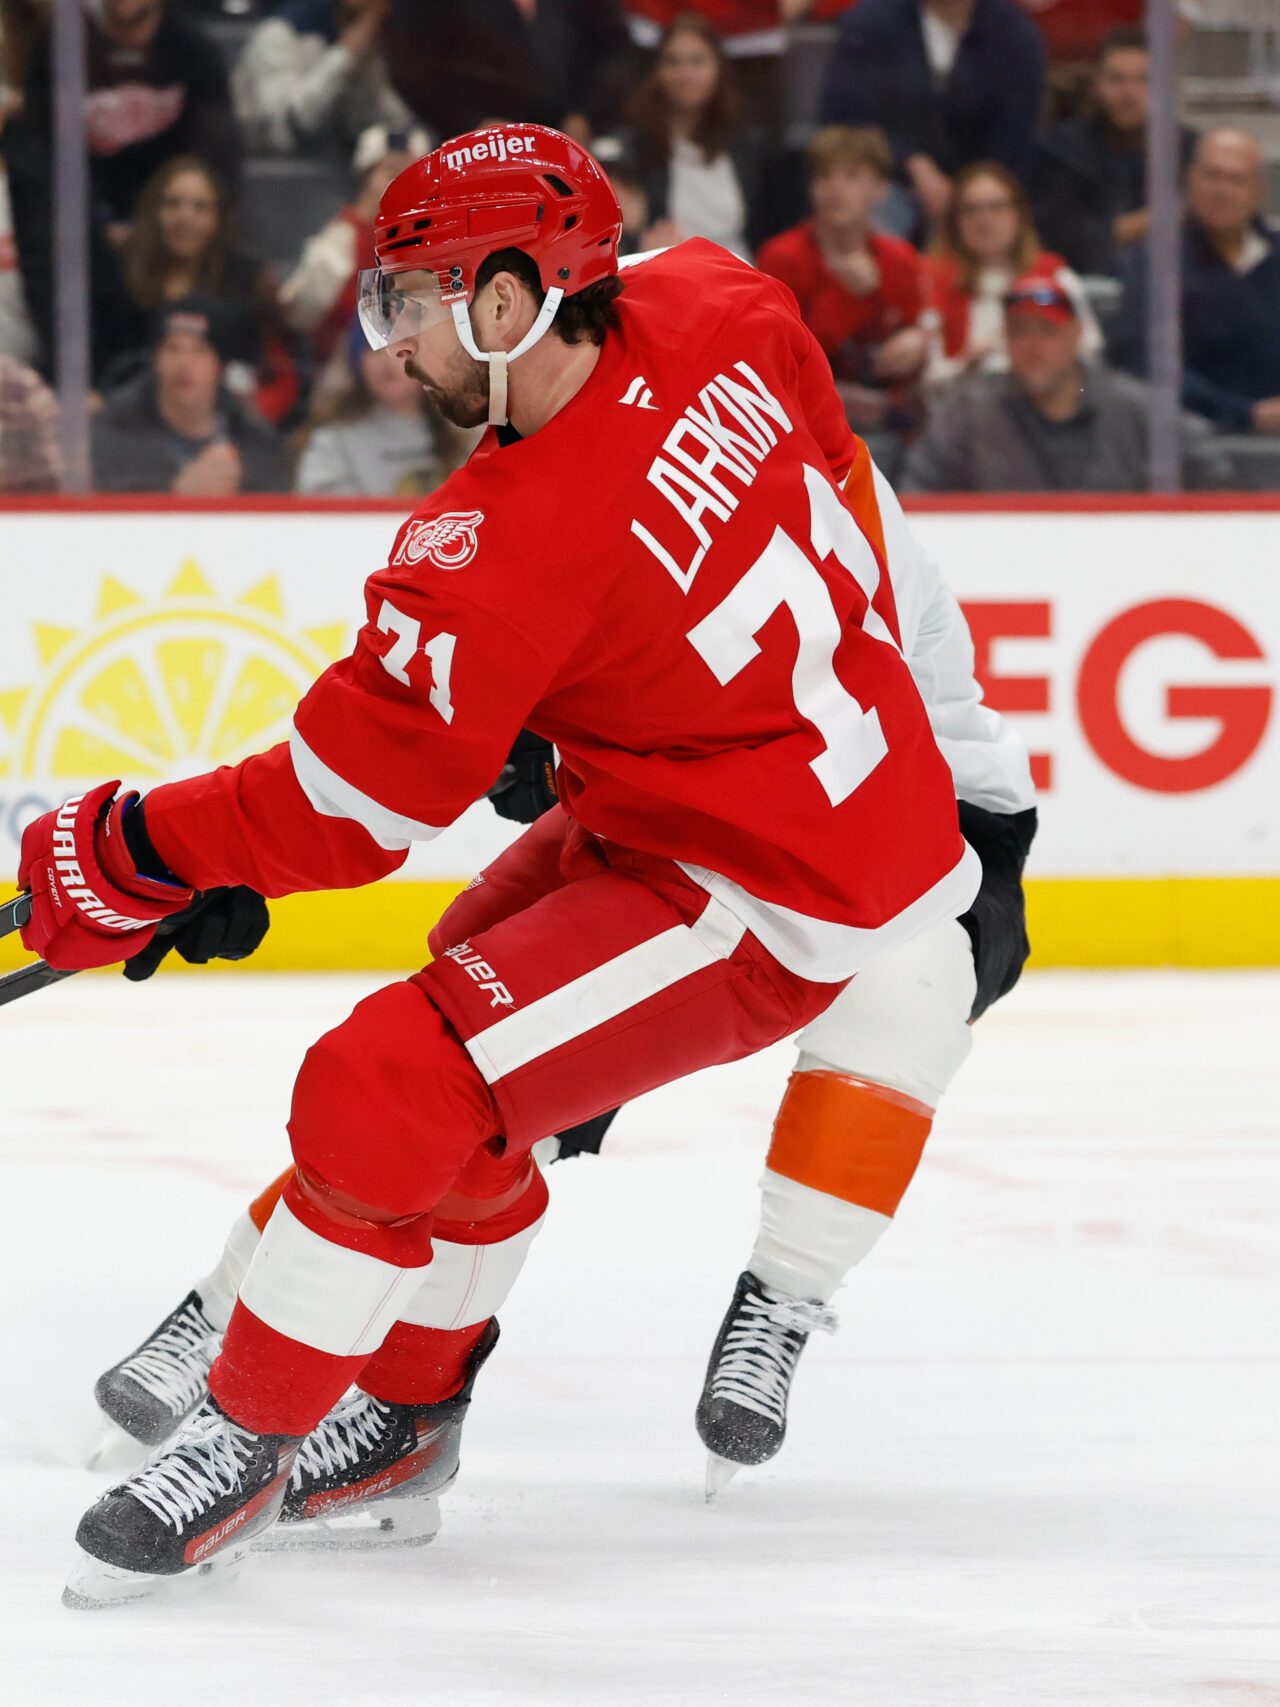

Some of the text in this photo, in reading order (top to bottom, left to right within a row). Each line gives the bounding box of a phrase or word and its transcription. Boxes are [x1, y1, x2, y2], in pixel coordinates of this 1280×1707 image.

[446, 133, 536, 170] meijer
[630, 360, 794, 596] LARKIN
[375, 598, 458, 726] 71
[685, 462, 909, 809] 71
[46, 866, 63, 909] COVERT
[192, 1509, 248, 1561] BAUER
